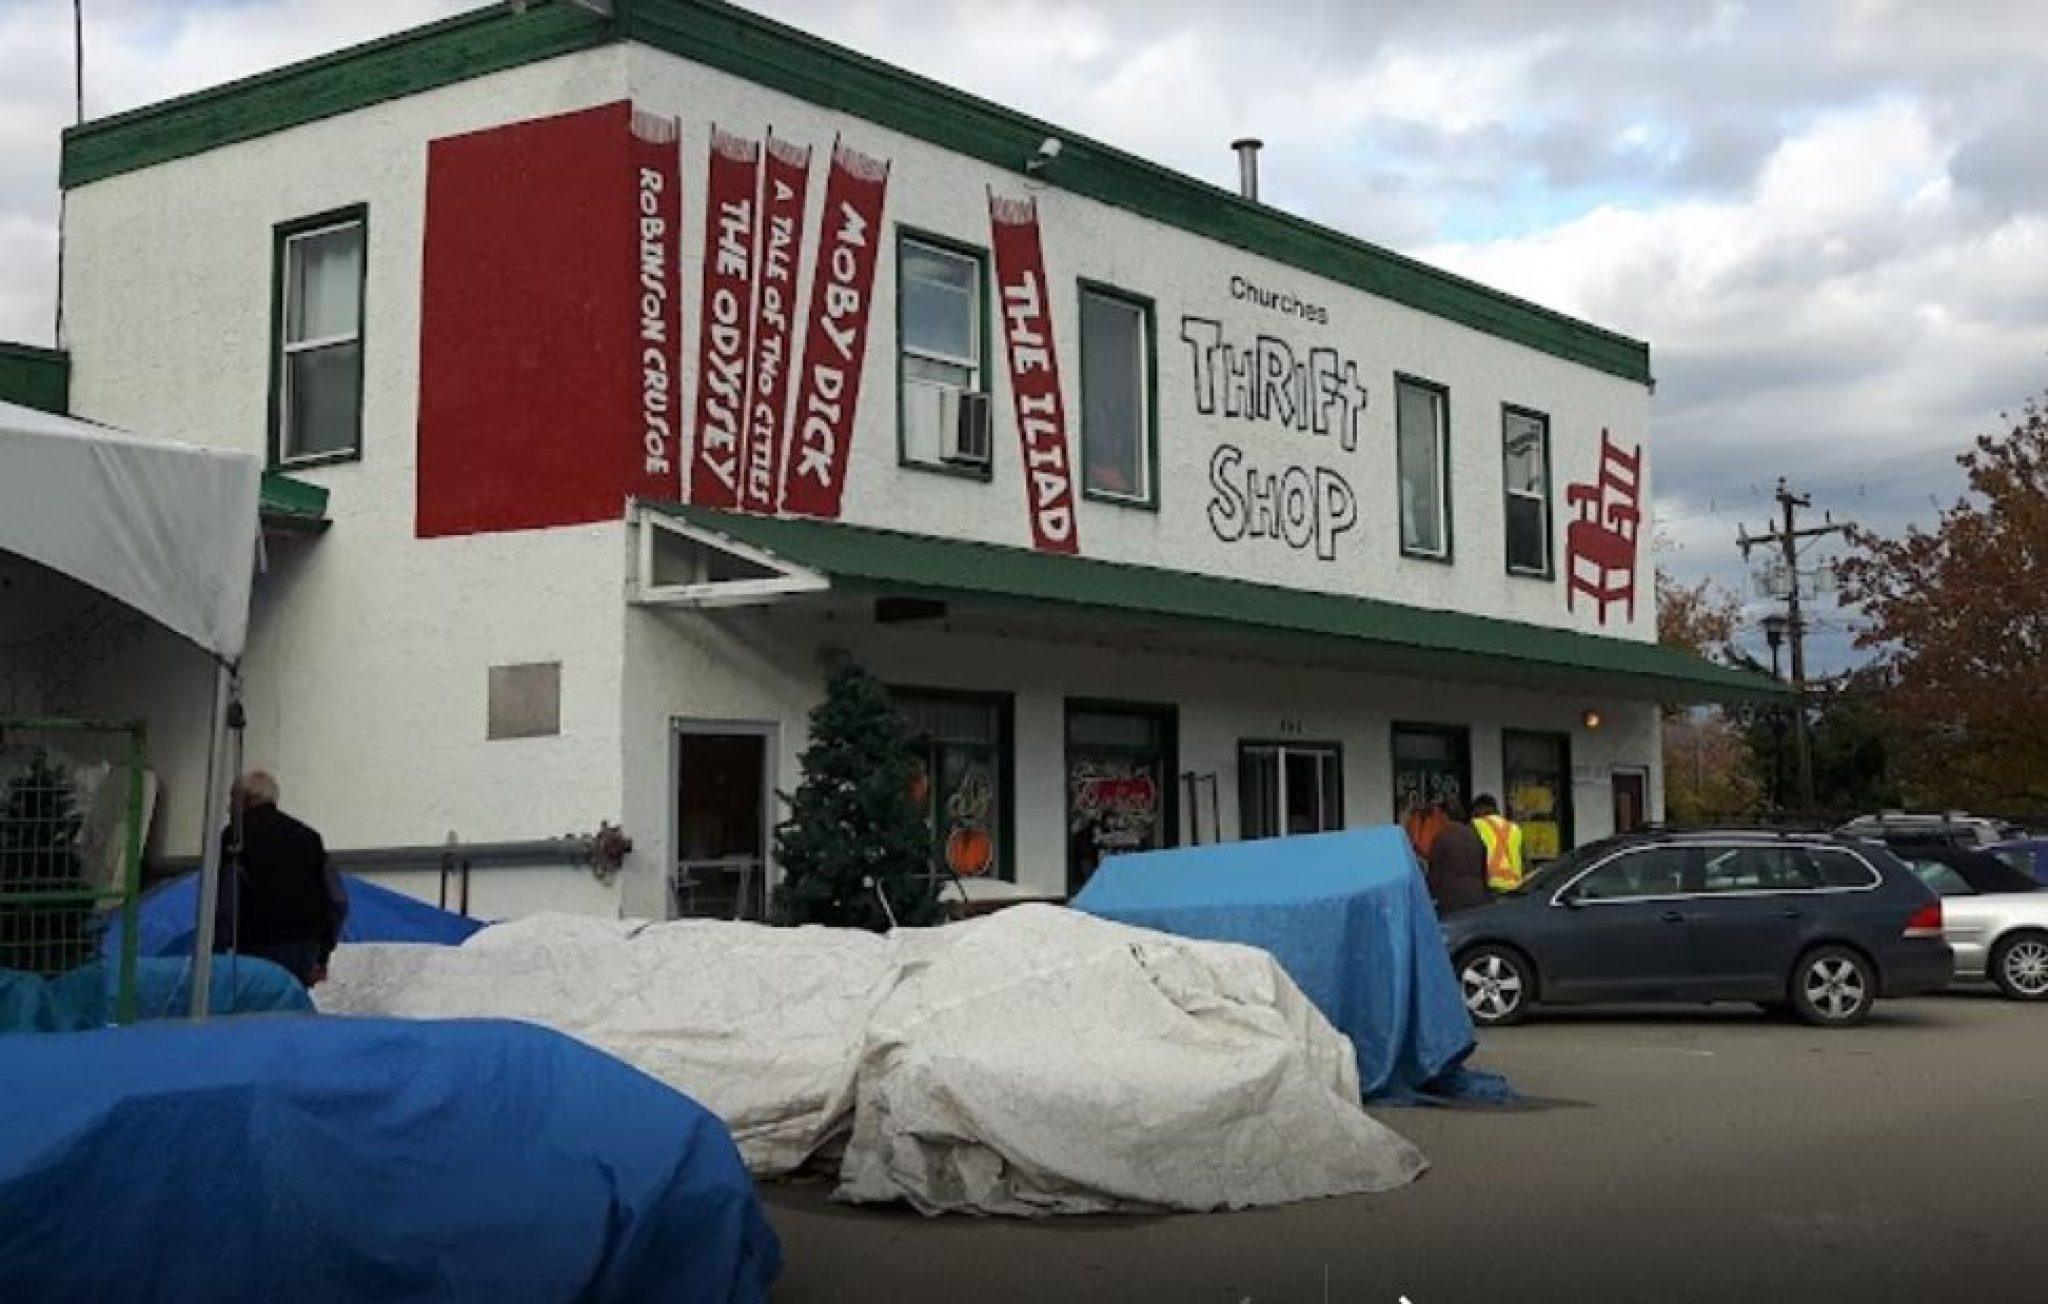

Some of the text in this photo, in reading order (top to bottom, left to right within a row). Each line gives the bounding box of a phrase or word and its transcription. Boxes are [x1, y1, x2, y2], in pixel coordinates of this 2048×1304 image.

[640, 168, 670, 474] ROBINSON CRUSOE
[701, 199, 750, 489] THE ODYSSEY
[750, 180, 793, 504] A TALE OF TWO CITIES
[797, 201, 868, 487] MOBY DICK
[1004, 271, 1070, 542] THE ILIAD
[1230, 275, 1329, 325] Churches
[1207, 444, 1358, 561] SHOP
